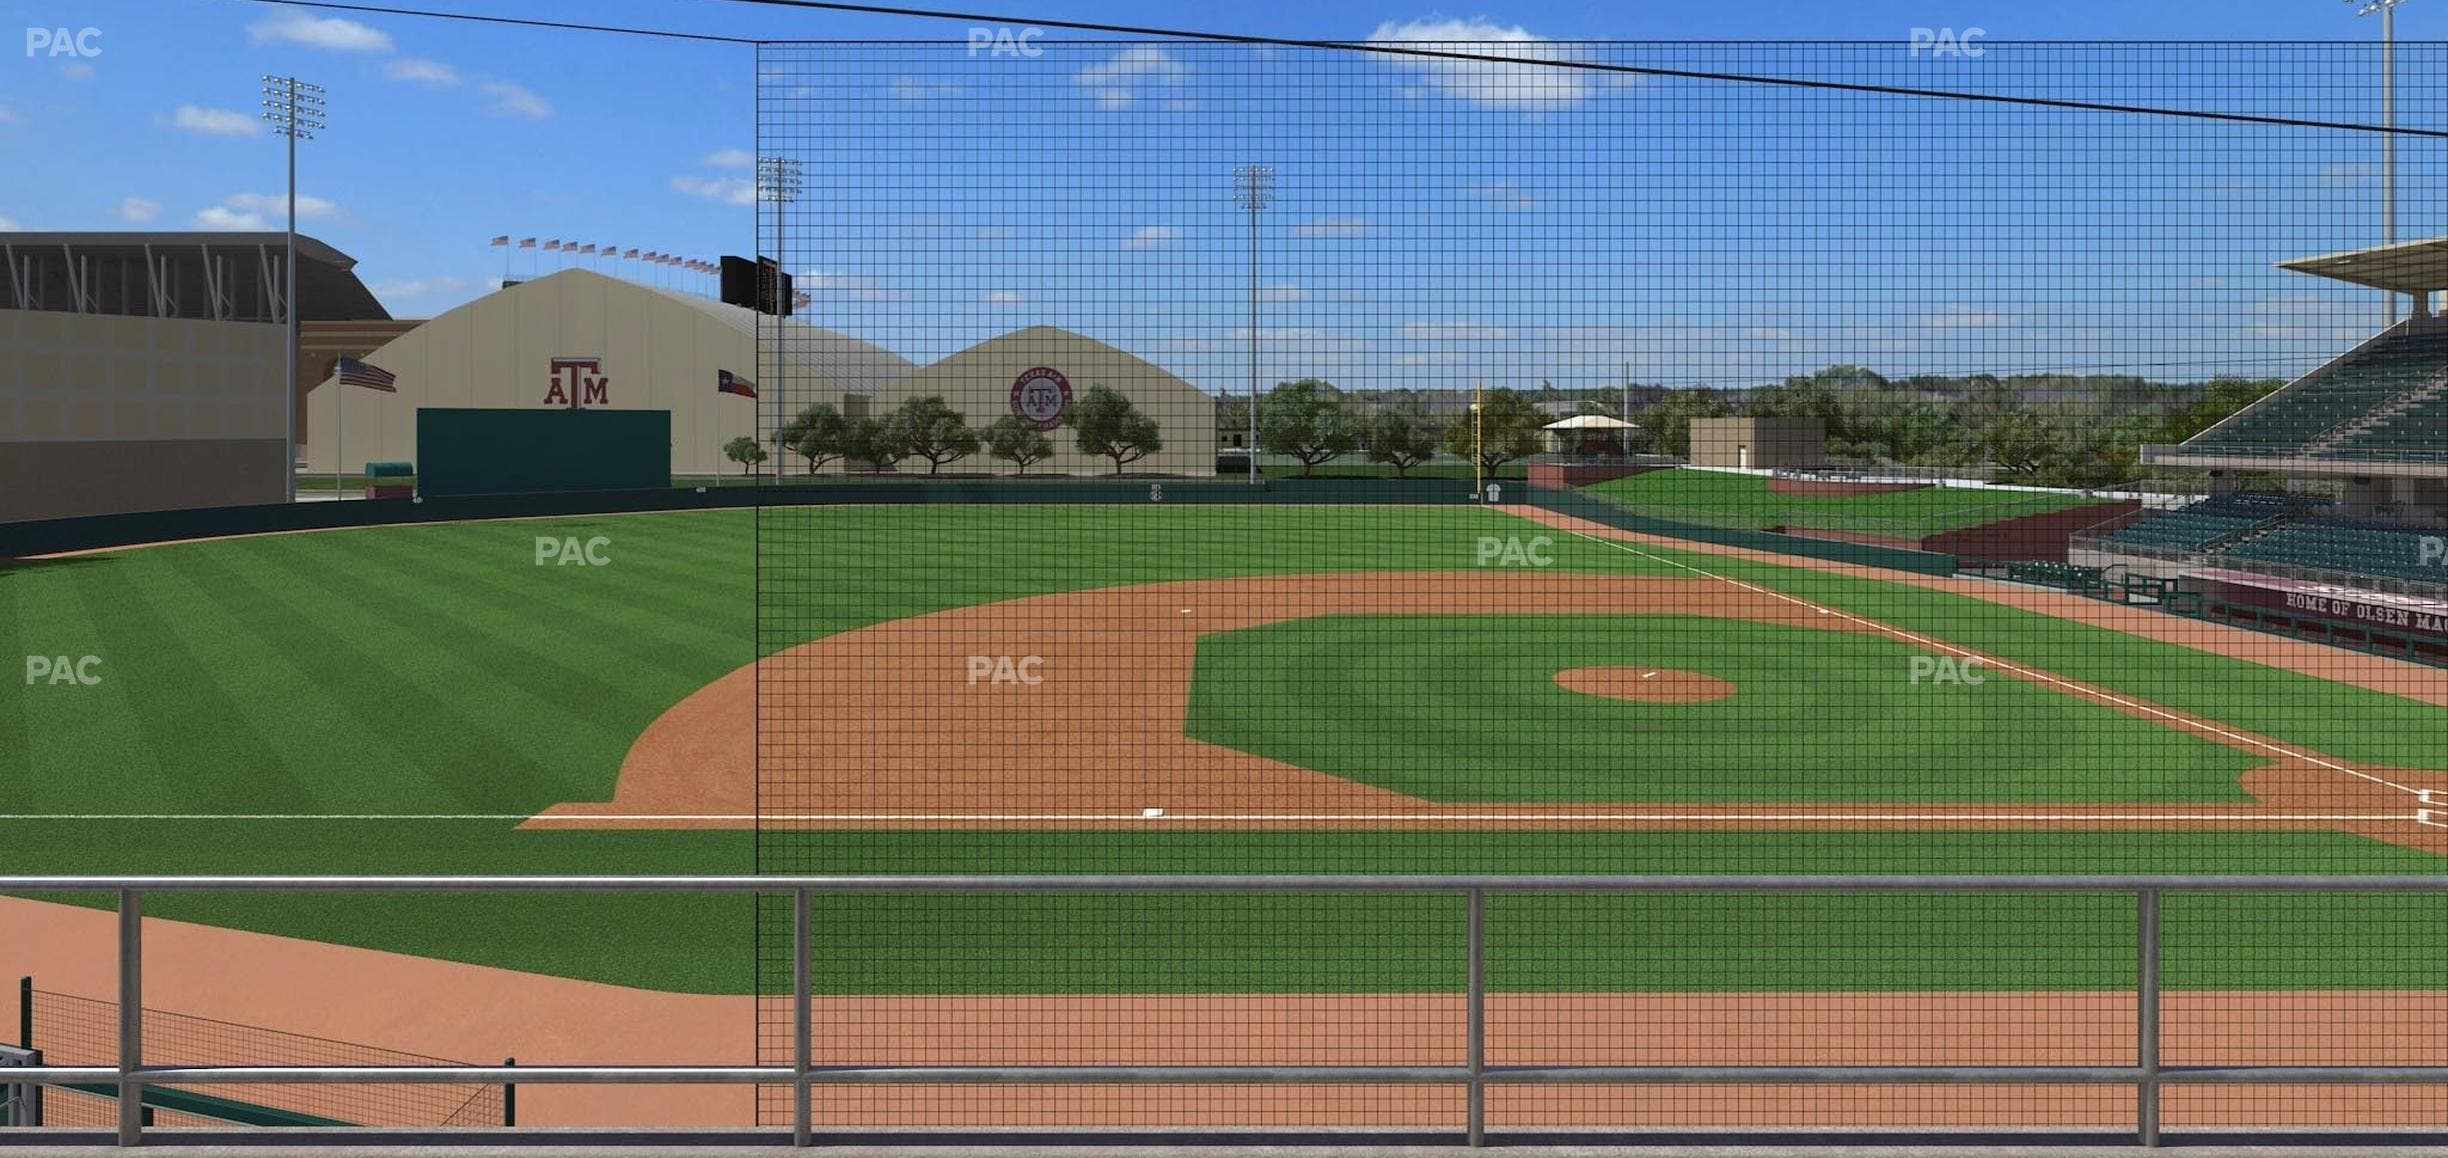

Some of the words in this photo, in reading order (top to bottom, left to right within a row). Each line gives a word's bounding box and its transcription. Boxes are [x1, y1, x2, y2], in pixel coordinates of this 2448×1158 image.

[2286, 593, 2327, 615] HOME
[2332, 600, 2350, 616] OF
[2357, 606, 2409, 626] OLSEN
